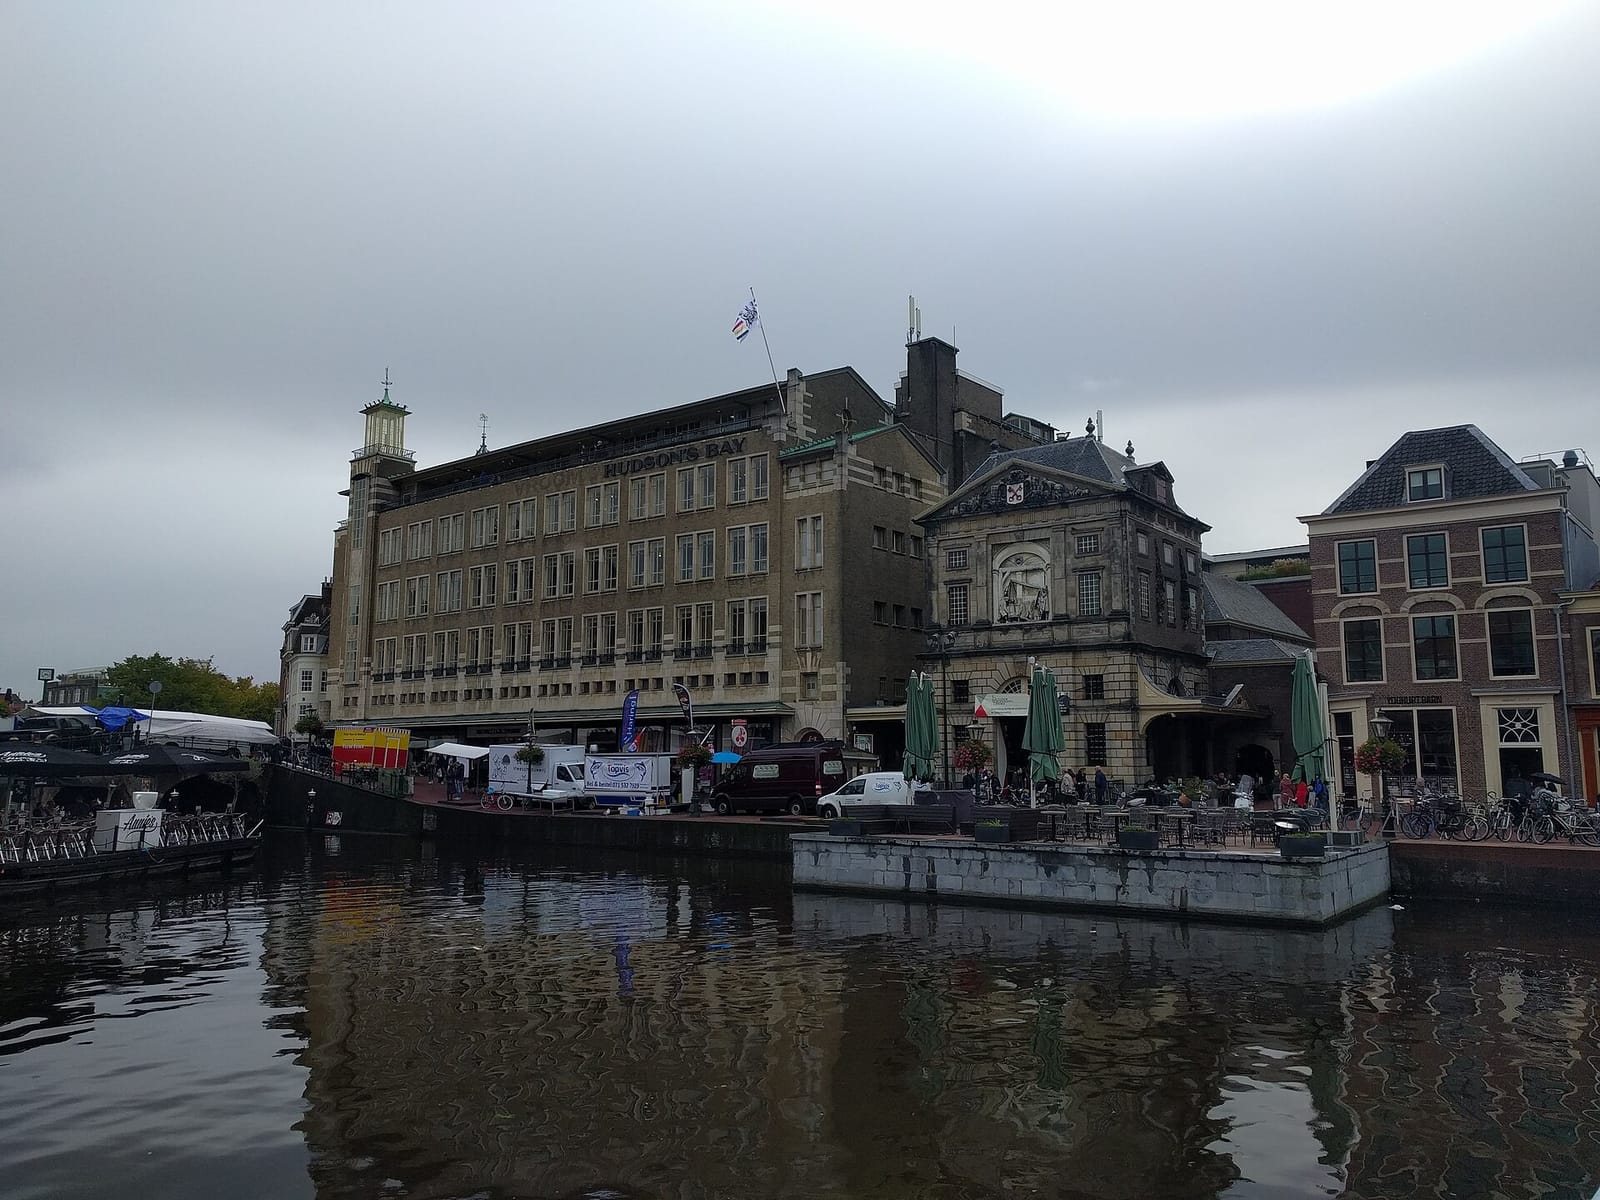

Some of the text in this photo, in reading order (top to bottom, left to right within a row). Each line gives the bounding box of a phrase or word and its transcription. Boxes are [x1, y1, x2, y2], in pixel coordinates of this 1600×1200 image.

[604, 437, 746, 478] HUDSON'S BAY
[607, 764, 629, 773] Topvis
